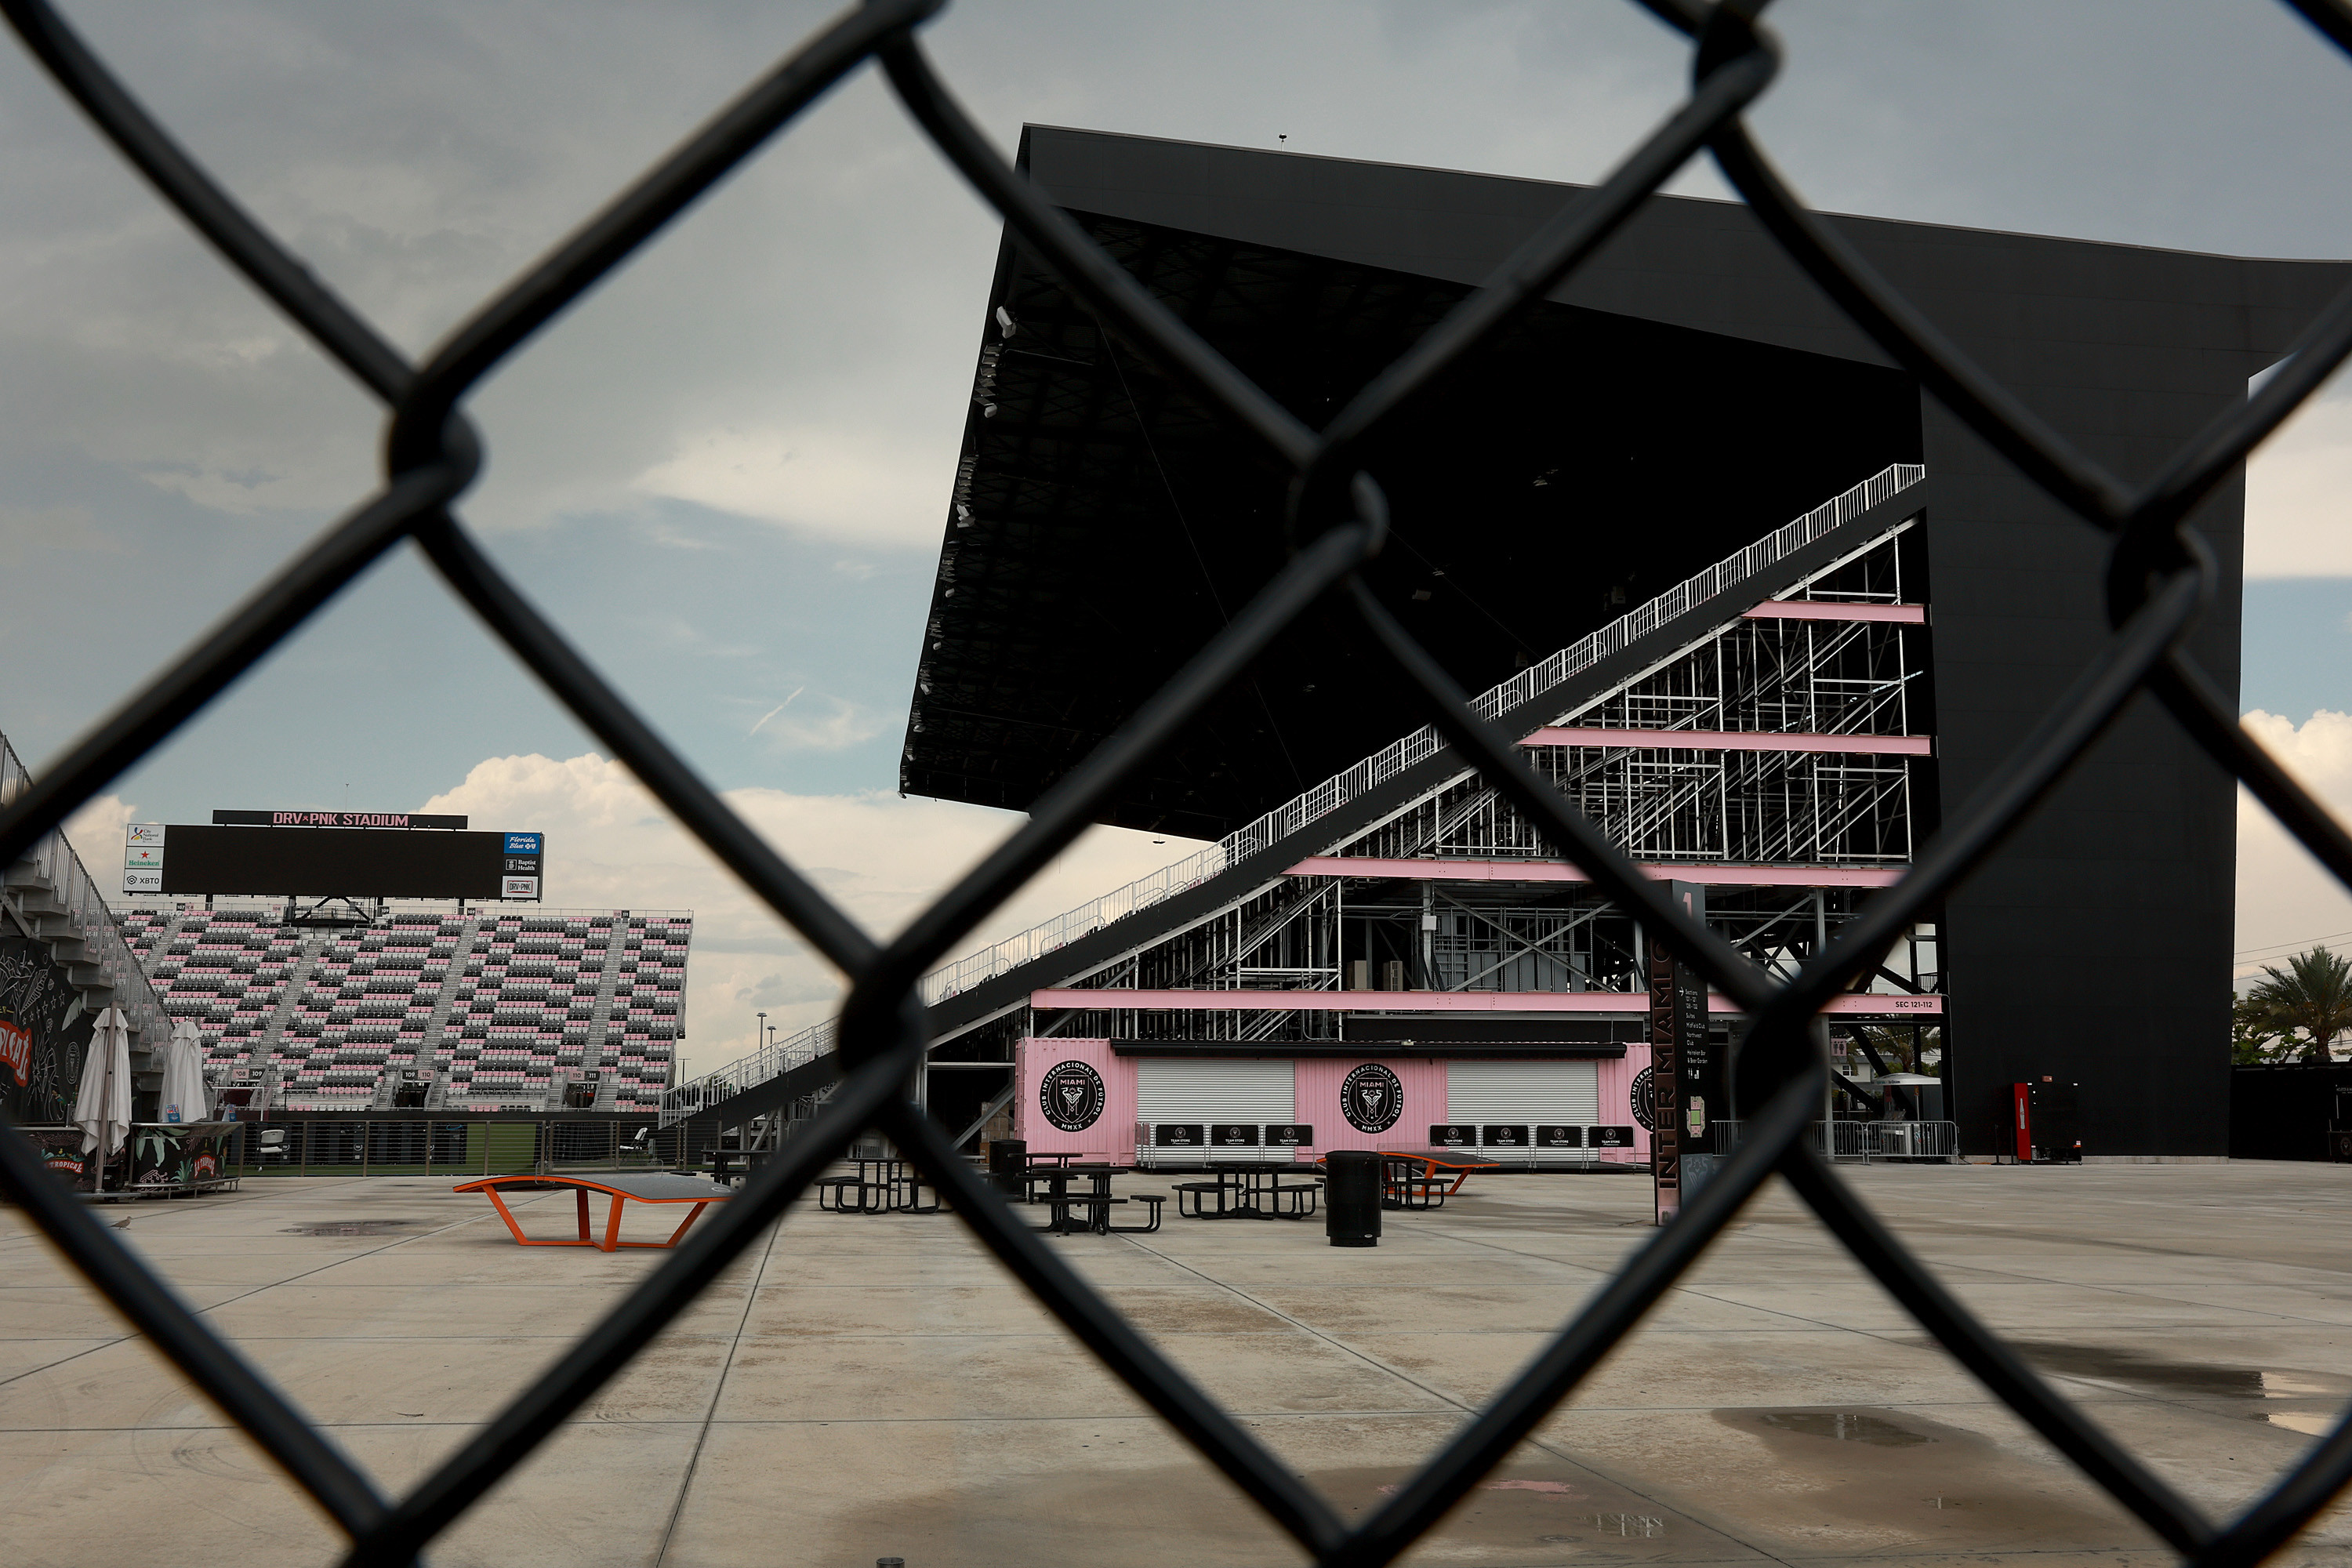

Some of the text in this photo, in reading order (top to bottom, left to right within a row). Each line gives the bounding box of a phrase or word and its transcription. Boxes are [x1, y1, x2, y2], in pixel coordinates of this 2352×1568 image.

[343, 814, 408, 826] STADIUM
[1653, 973, 1675, 1075] MIAMI
[1042, 1062, 1093, 1092] INTERNACIONAL
[1093, 1076, 1101, 1085] DE
[1342, 1065, 1392, 1094] INTERNACIONAL
[1392, 1078, 1399, 1087] DE
[1632, 1068, 1652, 1117] CLUB INTERNA
[1041, 1095, 1051, 1116] CLUB
[1341, 1098, 1351, 1117] CLUB
[1657, 1087, 1678, 1189] INTER
